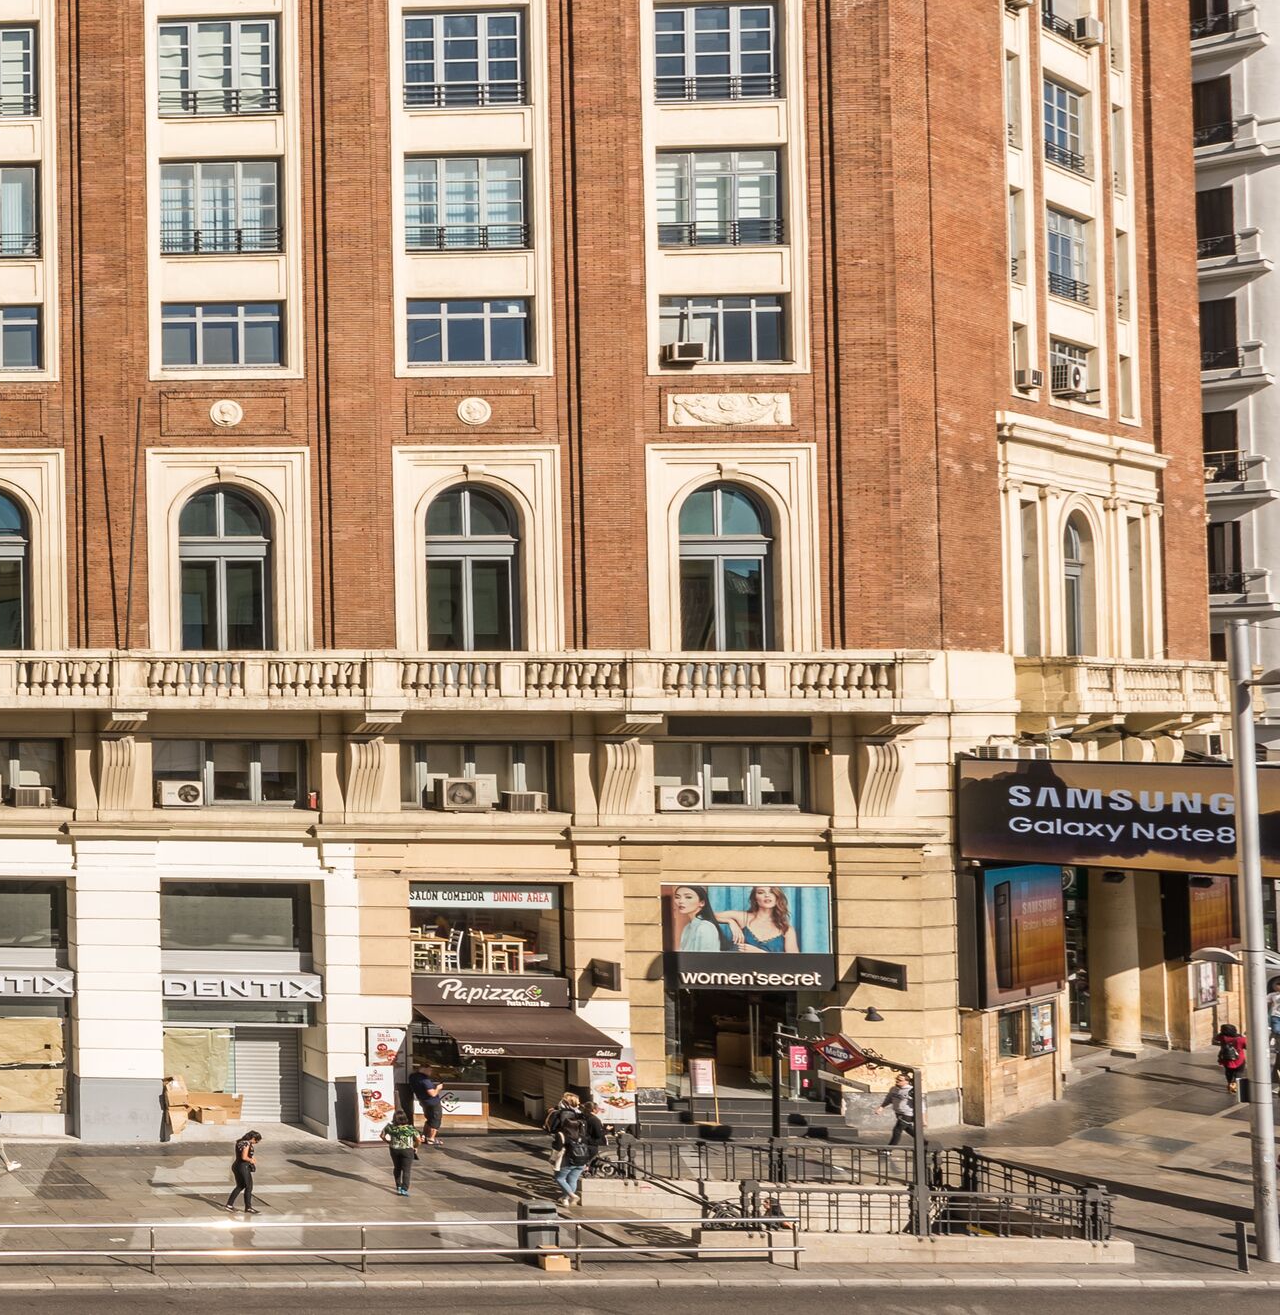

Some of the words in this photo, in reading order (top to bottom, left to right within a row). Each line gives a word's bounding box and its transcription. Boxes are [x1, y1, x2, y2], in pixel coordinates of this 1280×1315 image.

[1008, 784, 1235, 816] SAMSUNG
[1008, 816, 1125, 842] Galaxy
[1132, 823, 1237, 845] Note8
[409, 888, 439, 901] SALÓN
[442, 891, 485, 902] COMEDOR
[492, 891, 523, 903] DINING
[526, 892, 549, 903] AREA
[1022, 897, 1057, 915] SAMSUNG
[680, 971, 822, 986] women'secret
[162, 978, 322, 999] DENTIX
[437, 978, 529, 1004] Papizza
[462, 1044, 499, 1056] Papizza
[825, 1046, 848, 1059] Metro
